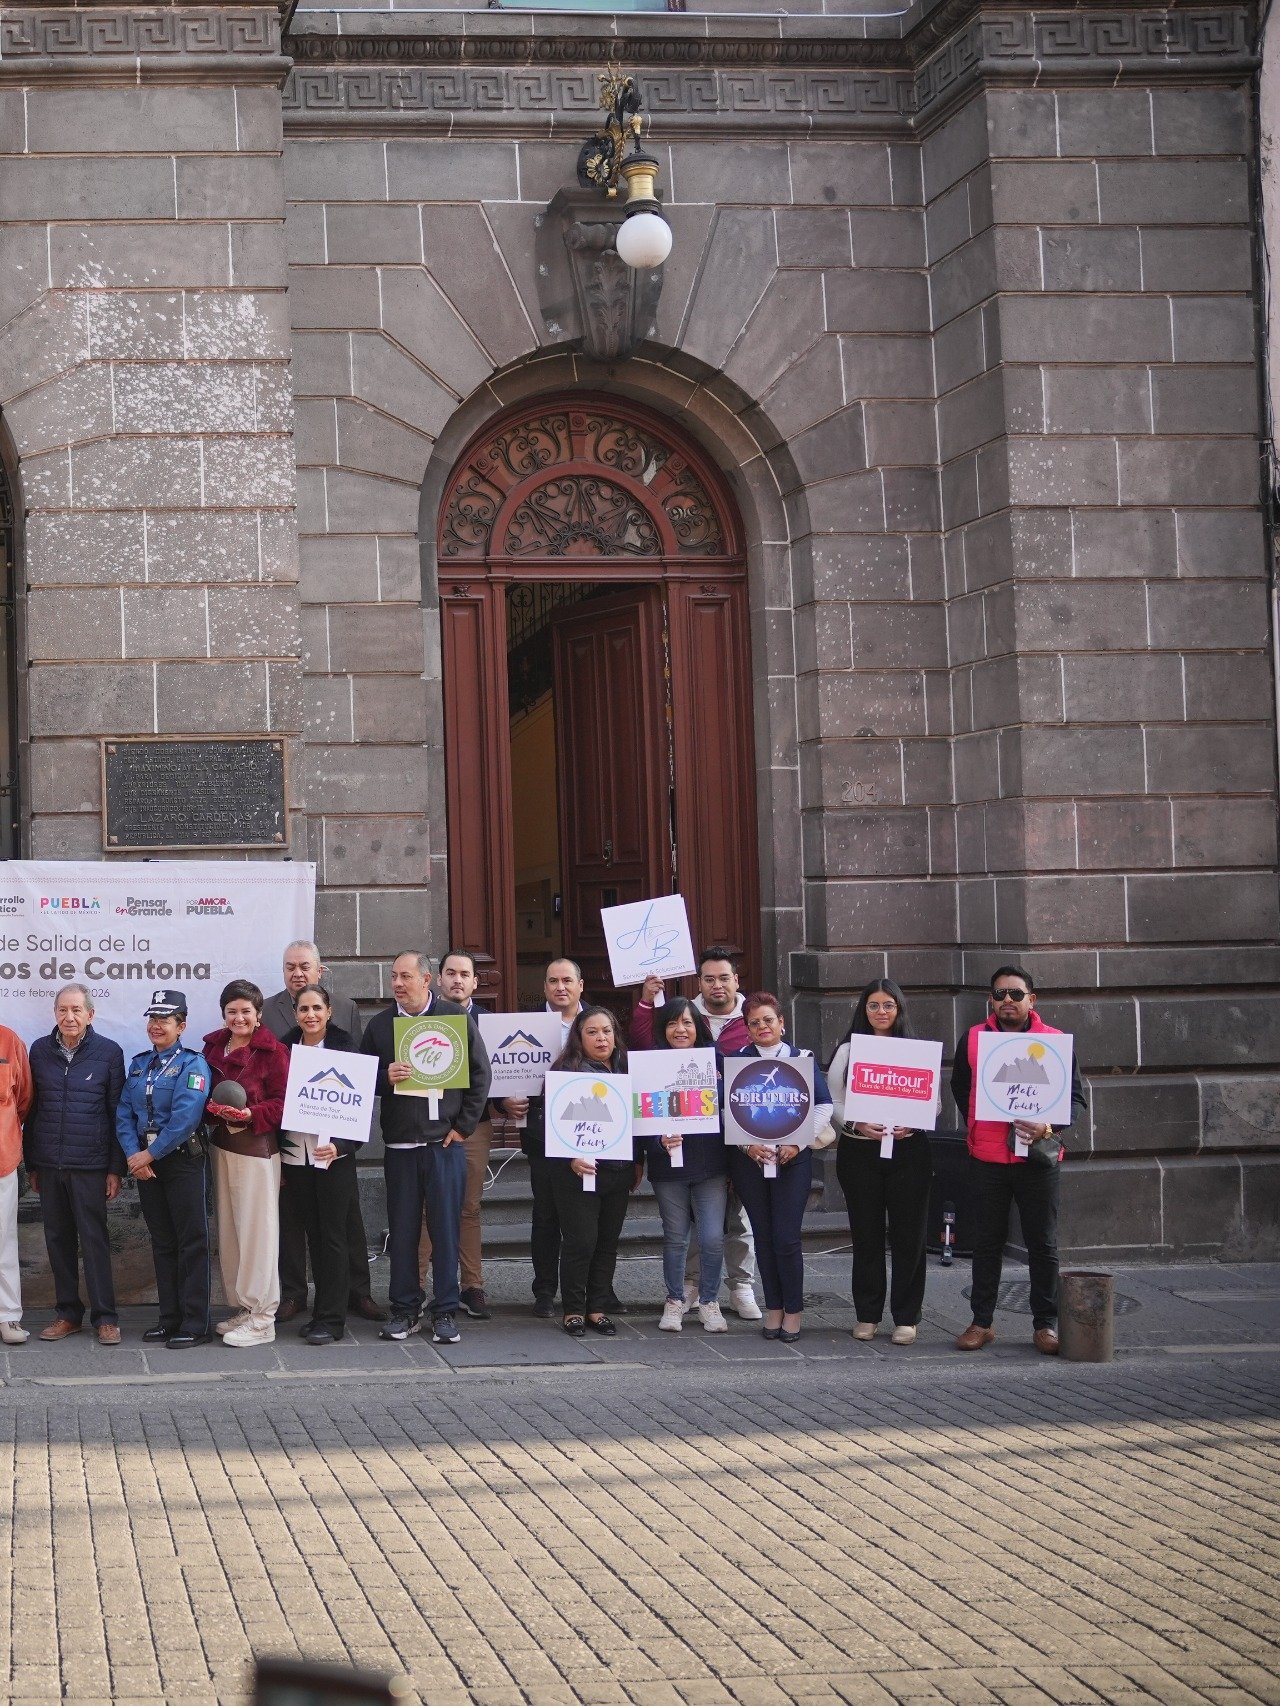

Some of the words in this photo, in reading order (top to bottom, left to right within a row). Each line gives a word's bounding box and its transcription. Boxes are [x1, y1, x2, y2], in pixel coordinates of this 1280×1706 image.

[140, 813, 187, 823] LAZARO
[192, 812, 252, 822] CARDENAS
[40, 897, 101, 909] PUEBLA
[126, 896, 168, 908] Pensar
[197, 898, 227, 906] AMOR
[128, 905, 173, 917] Grande
[186, 905, 235, 916] PUEBLA
[26, 934, 92, 952] Salida
[98, 934, 126, 952] de
[132, 934, 151, 952] la
[39, 956, 76, 980] de
[84, 956, 211, 981] Cantona
[0, 989, 10, 998] 12
[12, 989, 26, 998] de
[490, 1051, 552, 1065] ALTOUR
[861, 1067, 924, 1089] Turitour
[858, 1081, 873, 1089] Tours
[297, 1086, 363, 1107] ALTOUR
[730, 1092, 809, 1103] SERITURS
